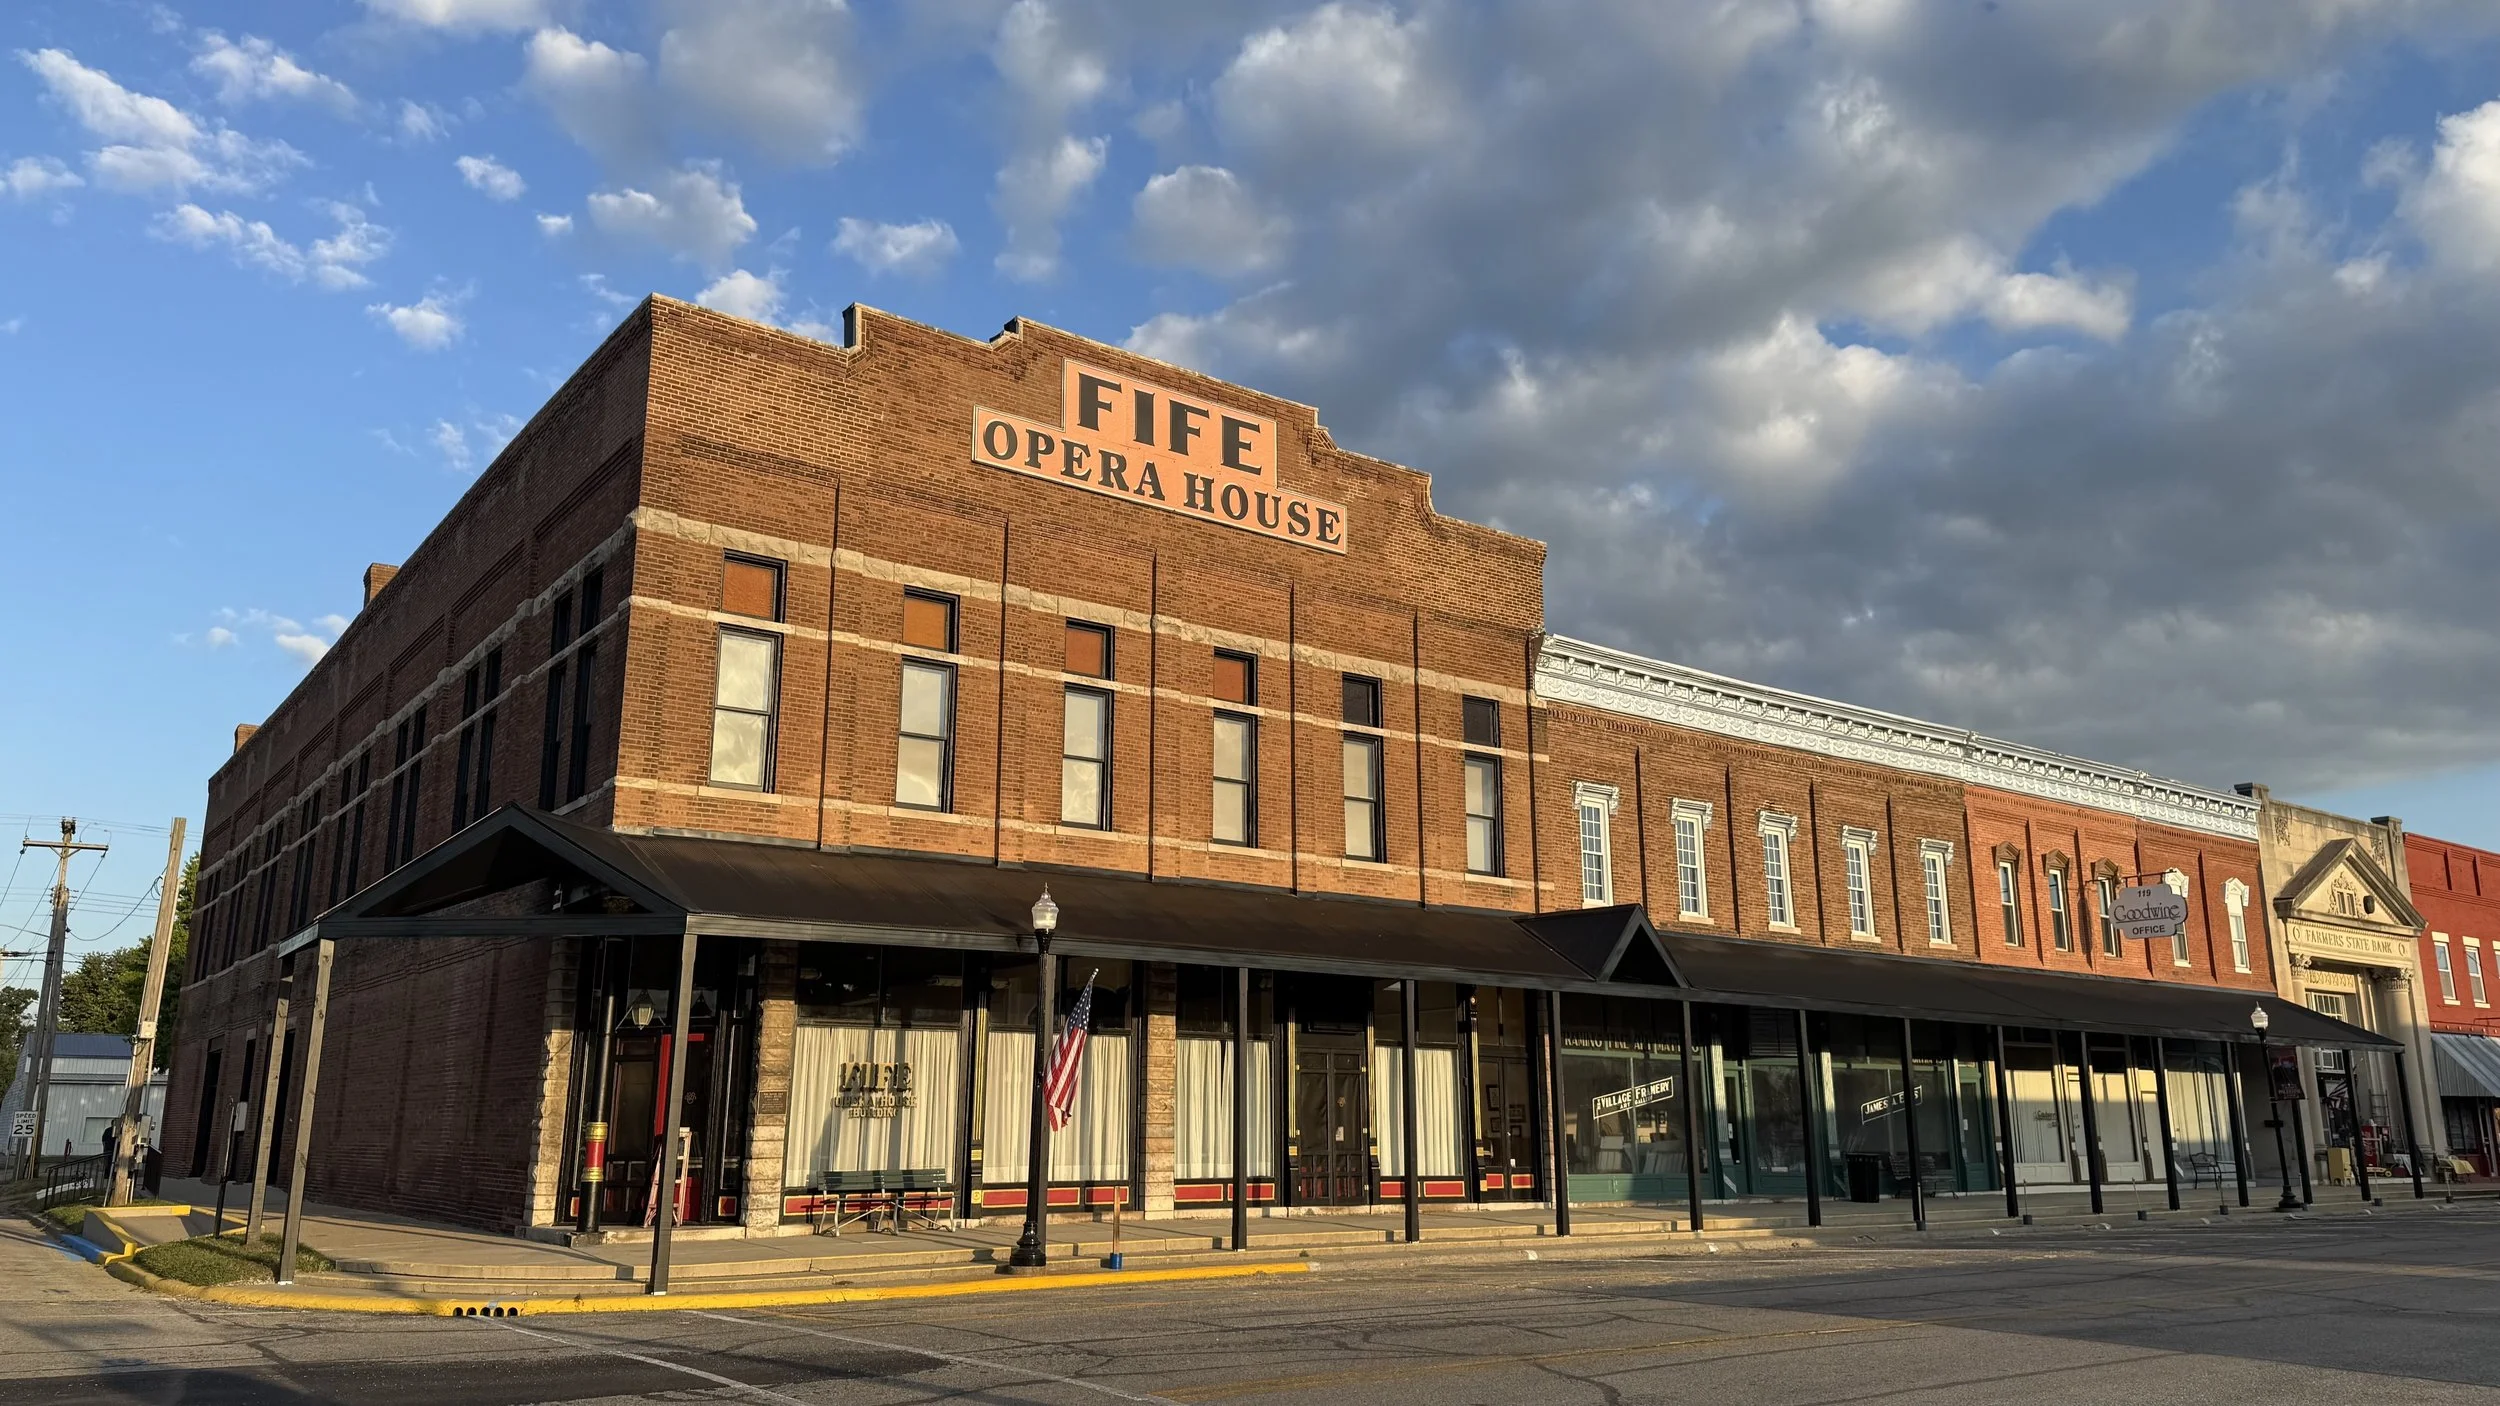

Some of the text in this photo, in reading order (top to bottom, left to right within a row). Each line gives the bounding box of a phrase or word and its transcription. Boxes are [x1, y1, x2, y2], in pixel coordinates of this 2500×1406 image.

[1077, 372, 1262, 475] FIFE
[983, 419, 1342, 546] OPERA HOUSE
[2137, 889, 2152, 898] 119
[2113, 901, 2181, 921] Goodwine
[2132, 924, 2166, 936] OFFICE
[2305, 929, 2394, 954] FARMERS STATE BANK
[880, 1095, 918, 1107] HOUSE
[1600, 1091, 1632, 1108] VILLAGE
[1635, 1081, 1670, 1100] FRAMERY
[1865, 1099, 1889, 1114] JAMES
[13, 1124, 34, 1135] 25
